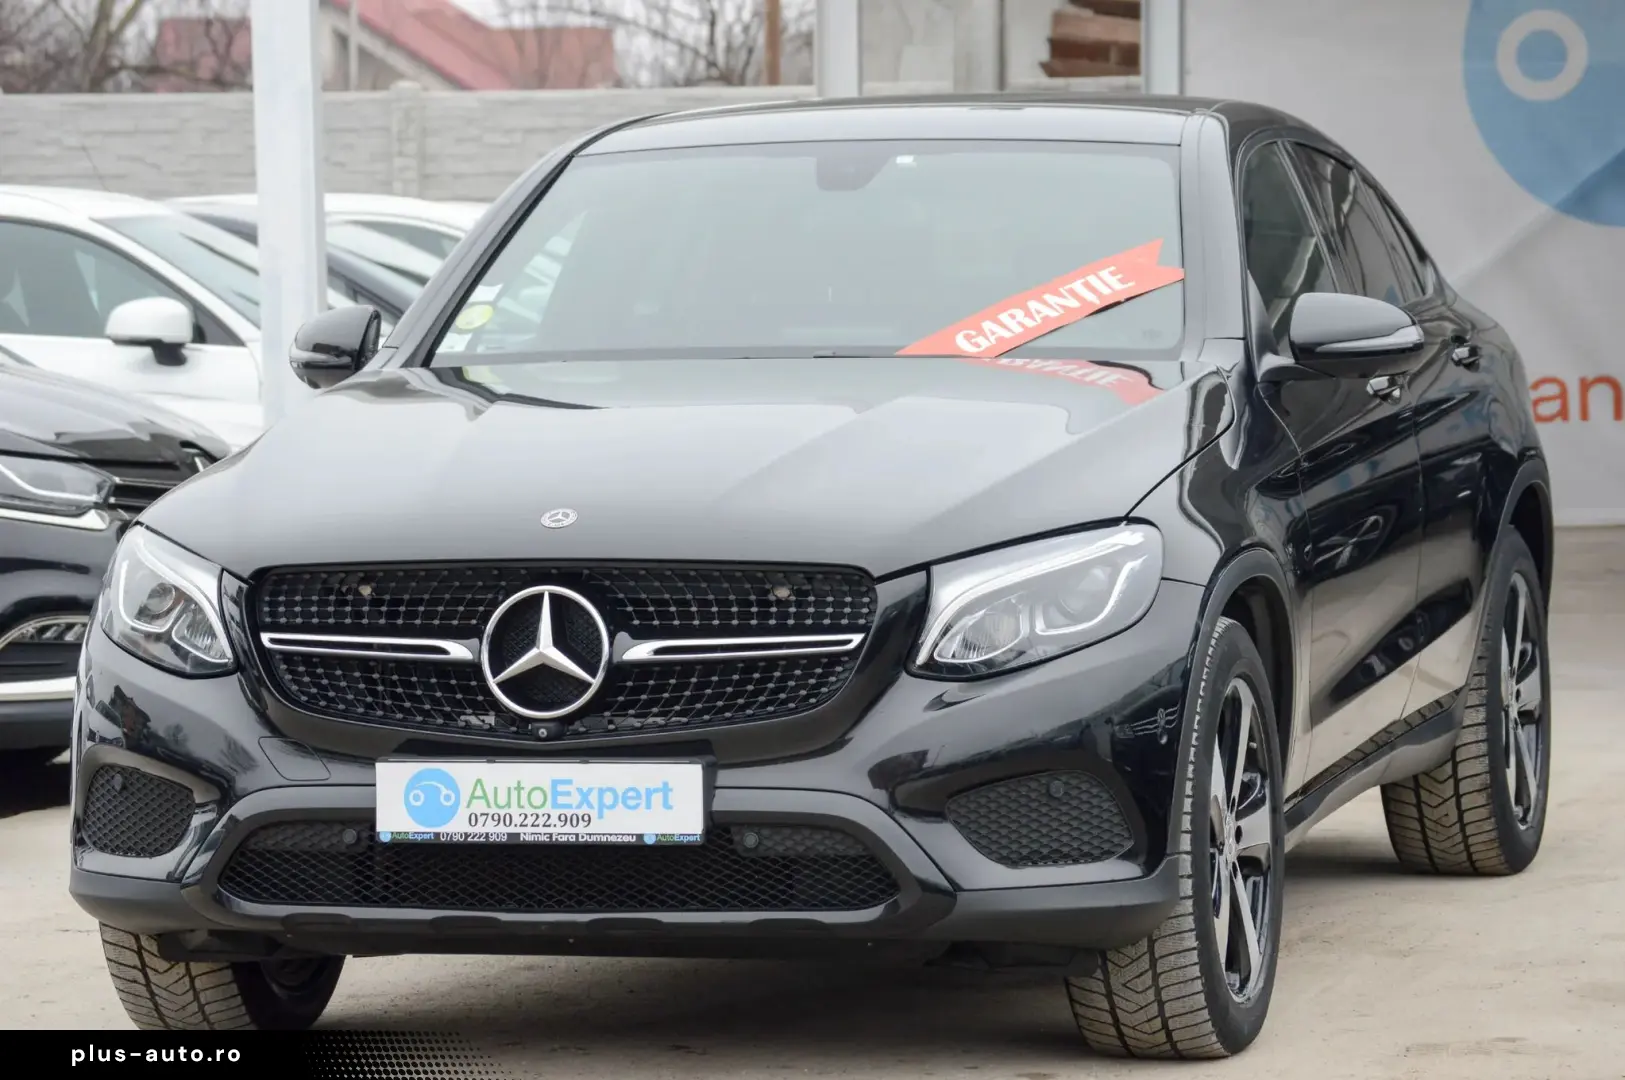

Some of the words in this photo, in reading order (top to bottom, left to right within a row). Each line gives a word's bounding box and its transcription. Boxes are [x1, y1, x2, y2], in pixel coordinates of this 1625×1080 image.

[466, 777, 674, 819] AutoExpert
[468, 812, 592, 829] 0790.222.909
[391, 831, 434, 841] AutoExpert
[439, 832, 464, 842] 0790
[467, 832, 486, 842] 222
[489, 832, 508, 842] 909
[520, 832, 550, 842] Nimic
[578, 833, 637, 842] Dumnezeu
[656, 833, 701, 843] AutoExpert
